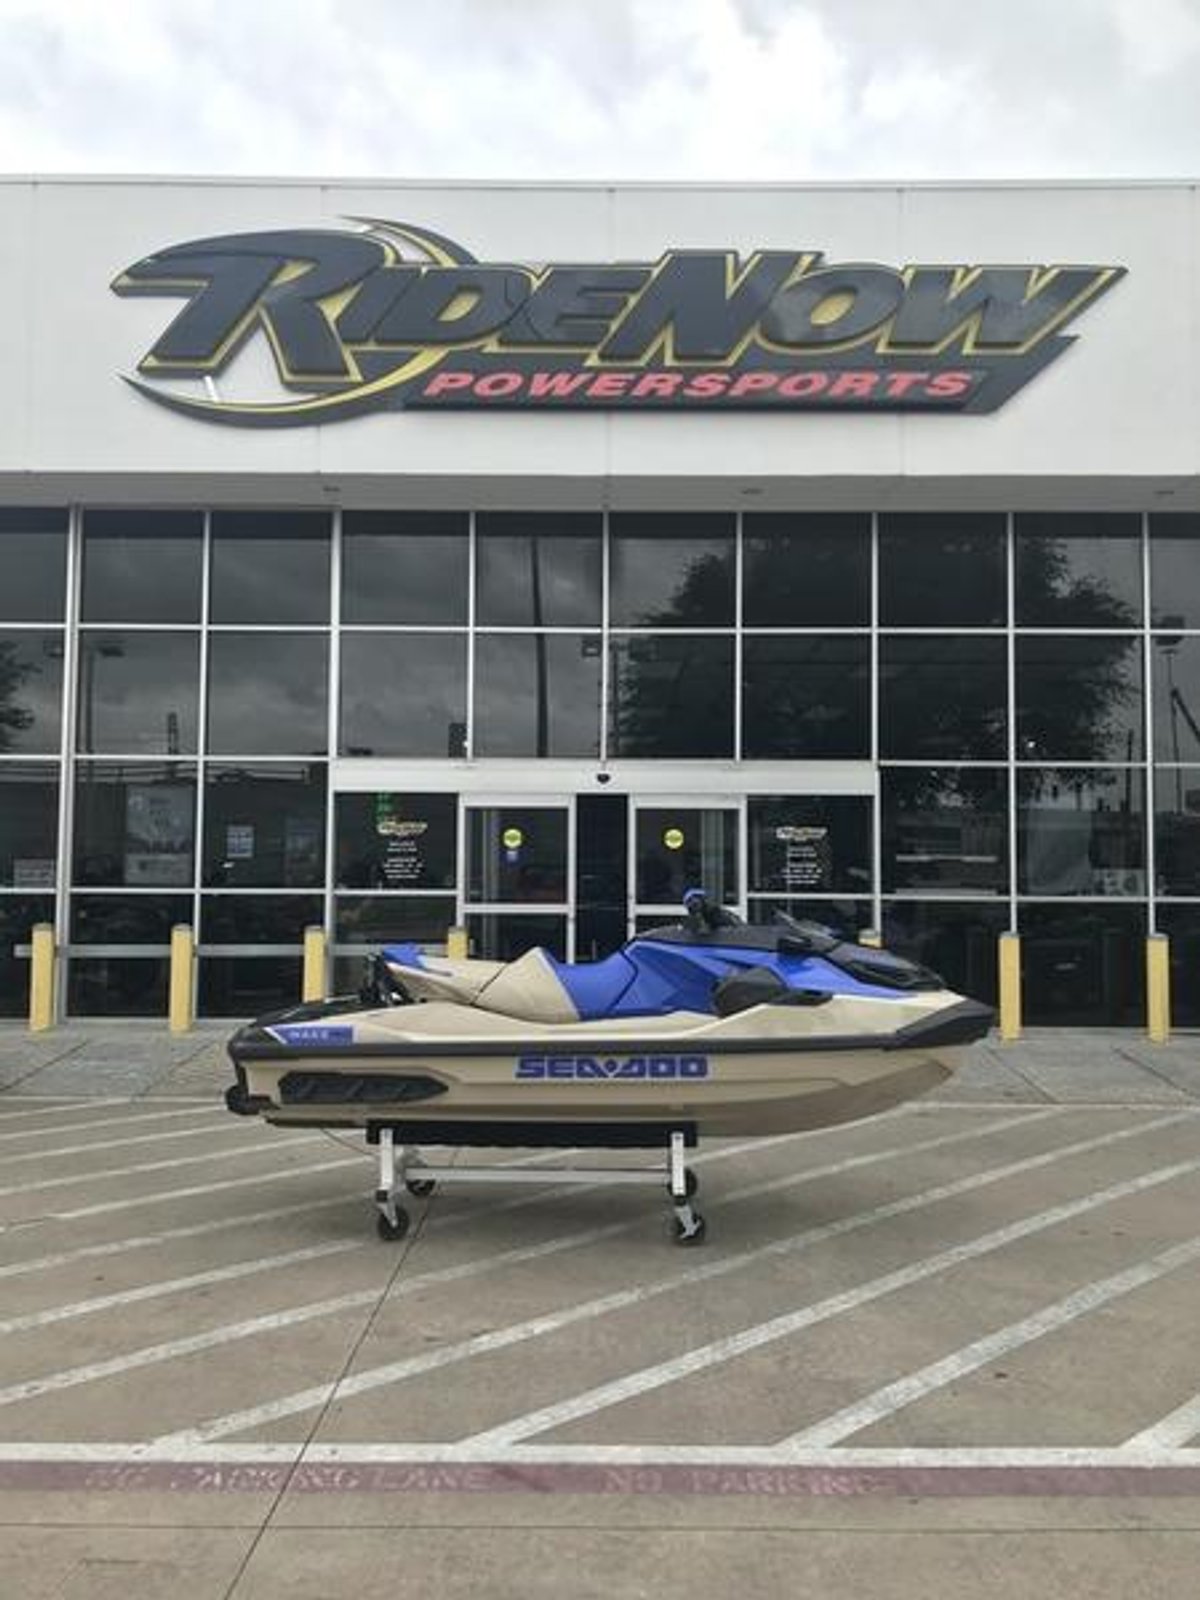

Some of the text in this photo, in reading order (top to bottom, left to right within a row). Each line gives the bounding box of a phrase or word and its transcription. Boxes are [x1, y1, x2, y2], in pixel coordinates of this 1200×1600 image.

[423, 372, 972, 398] POWERSPORTS
[372, 1466, 492, 1490] LANE
[603, 1468, 664, 1493] NO
